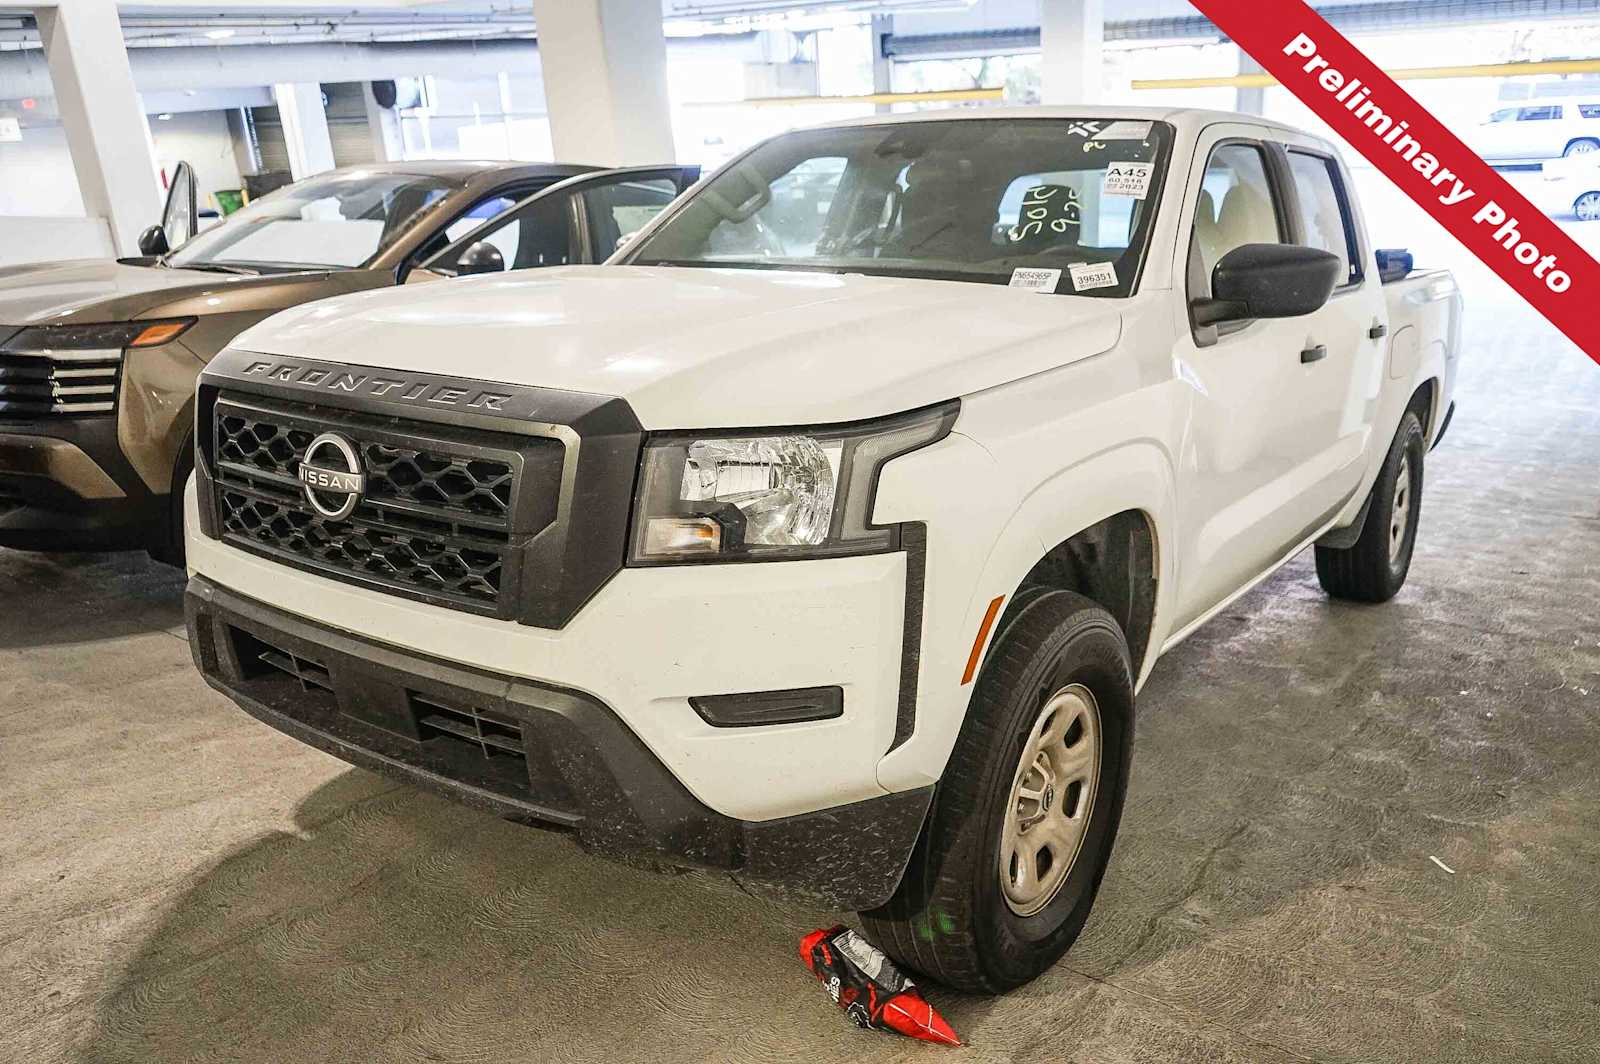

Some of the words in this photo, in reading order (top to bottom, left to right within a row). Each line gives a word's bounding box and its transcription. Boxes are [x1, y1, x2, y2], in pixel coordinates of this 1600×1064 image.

[1107, 168, 1148, 178] A45
[1077, 272, 1112, 285] 396351
[243, 361, 513, 411] FRONTIER
[298, 466, 359, 491] NISSAN
